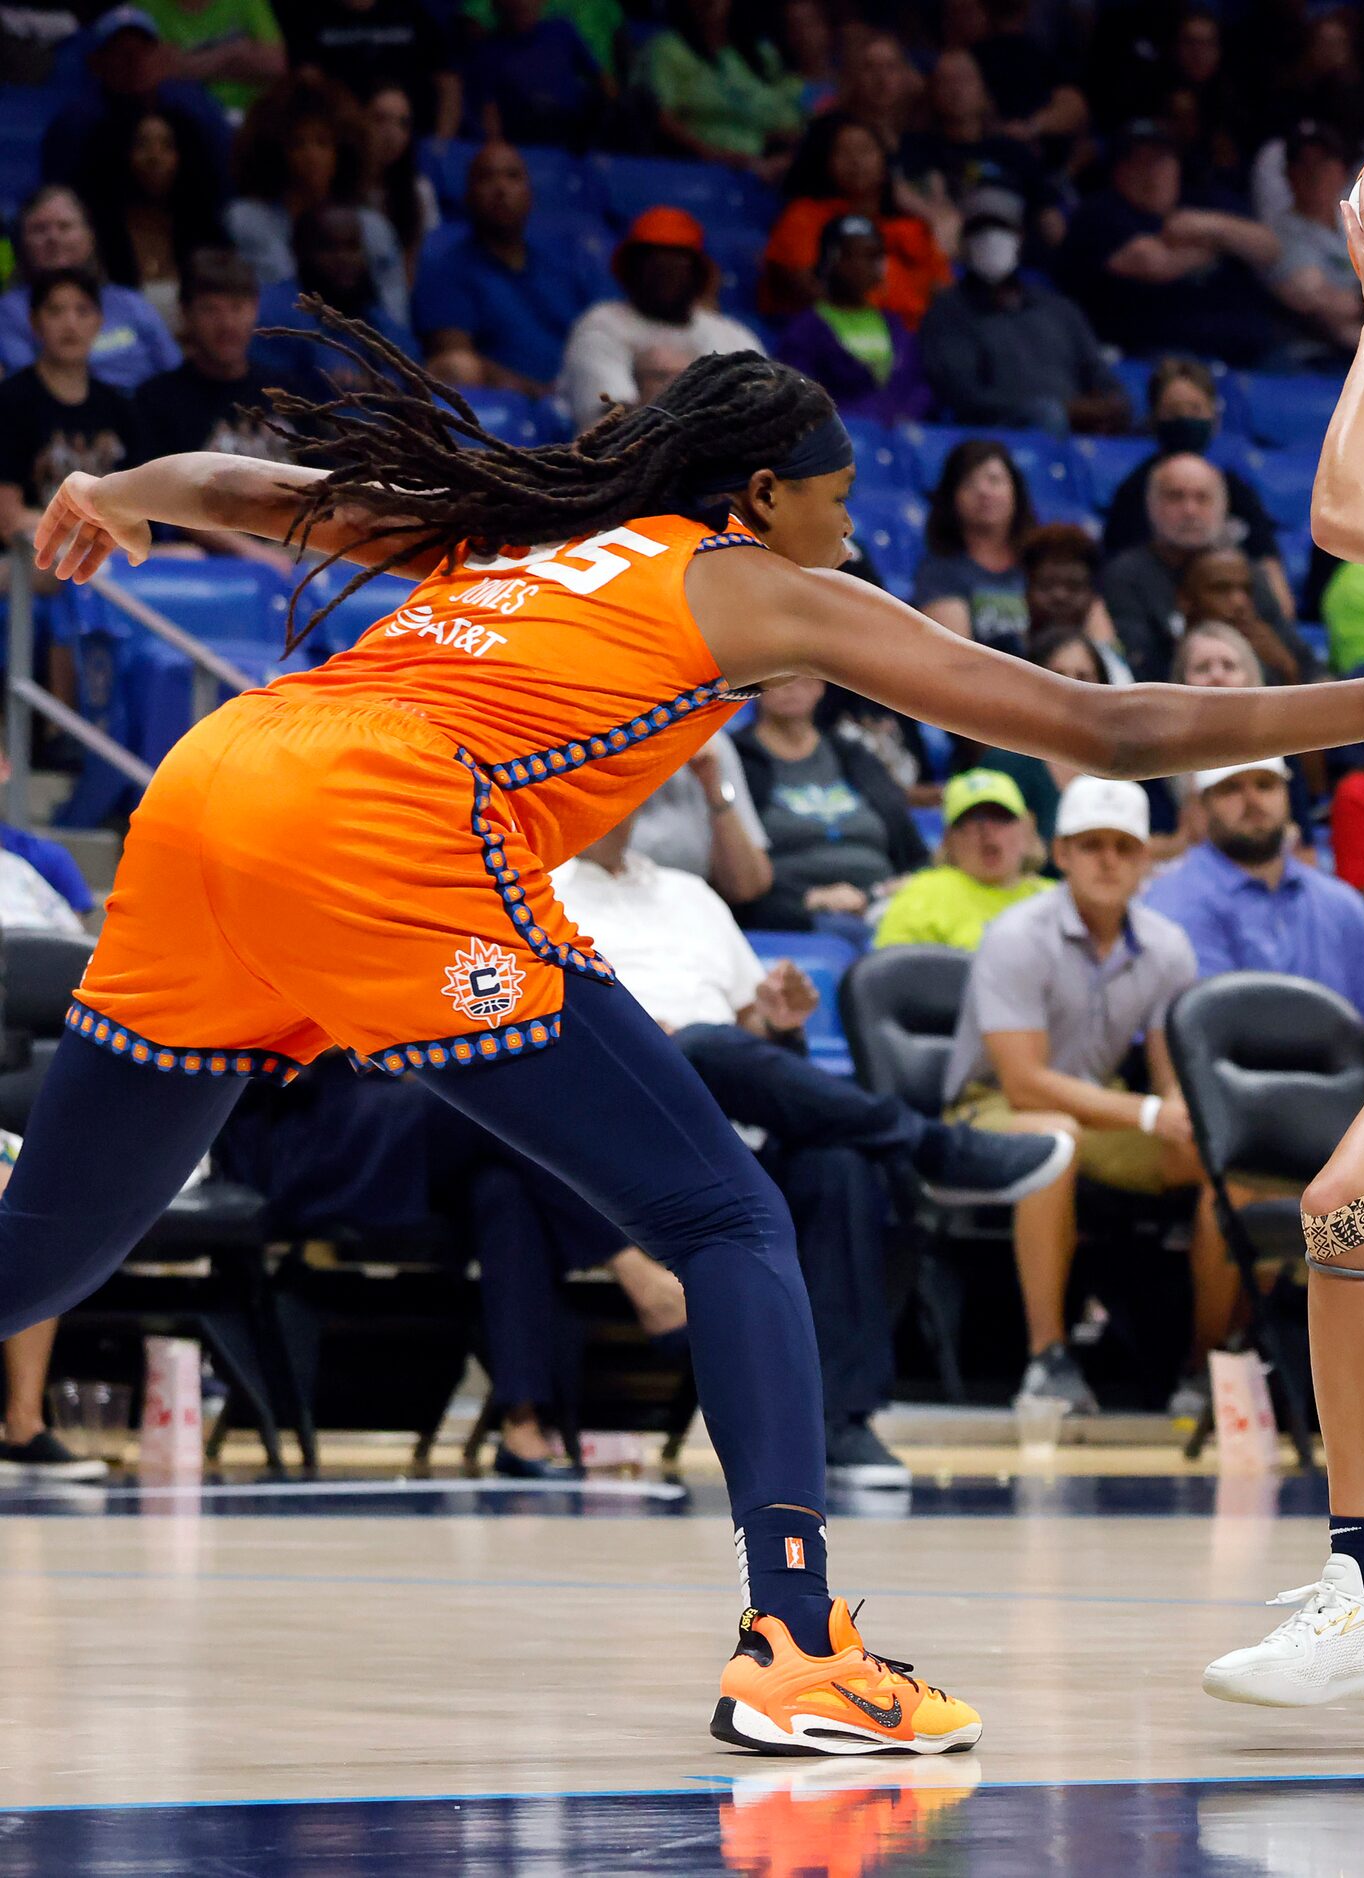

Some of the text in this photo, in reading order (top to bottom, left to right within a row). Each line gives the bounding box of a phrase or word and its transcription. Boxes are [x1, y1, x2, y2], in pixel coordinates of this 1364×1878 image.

[449, 576, 539, 615] JONES
[417, 617, 508, 658] AT&T
[469, 967, 501, 998] C
